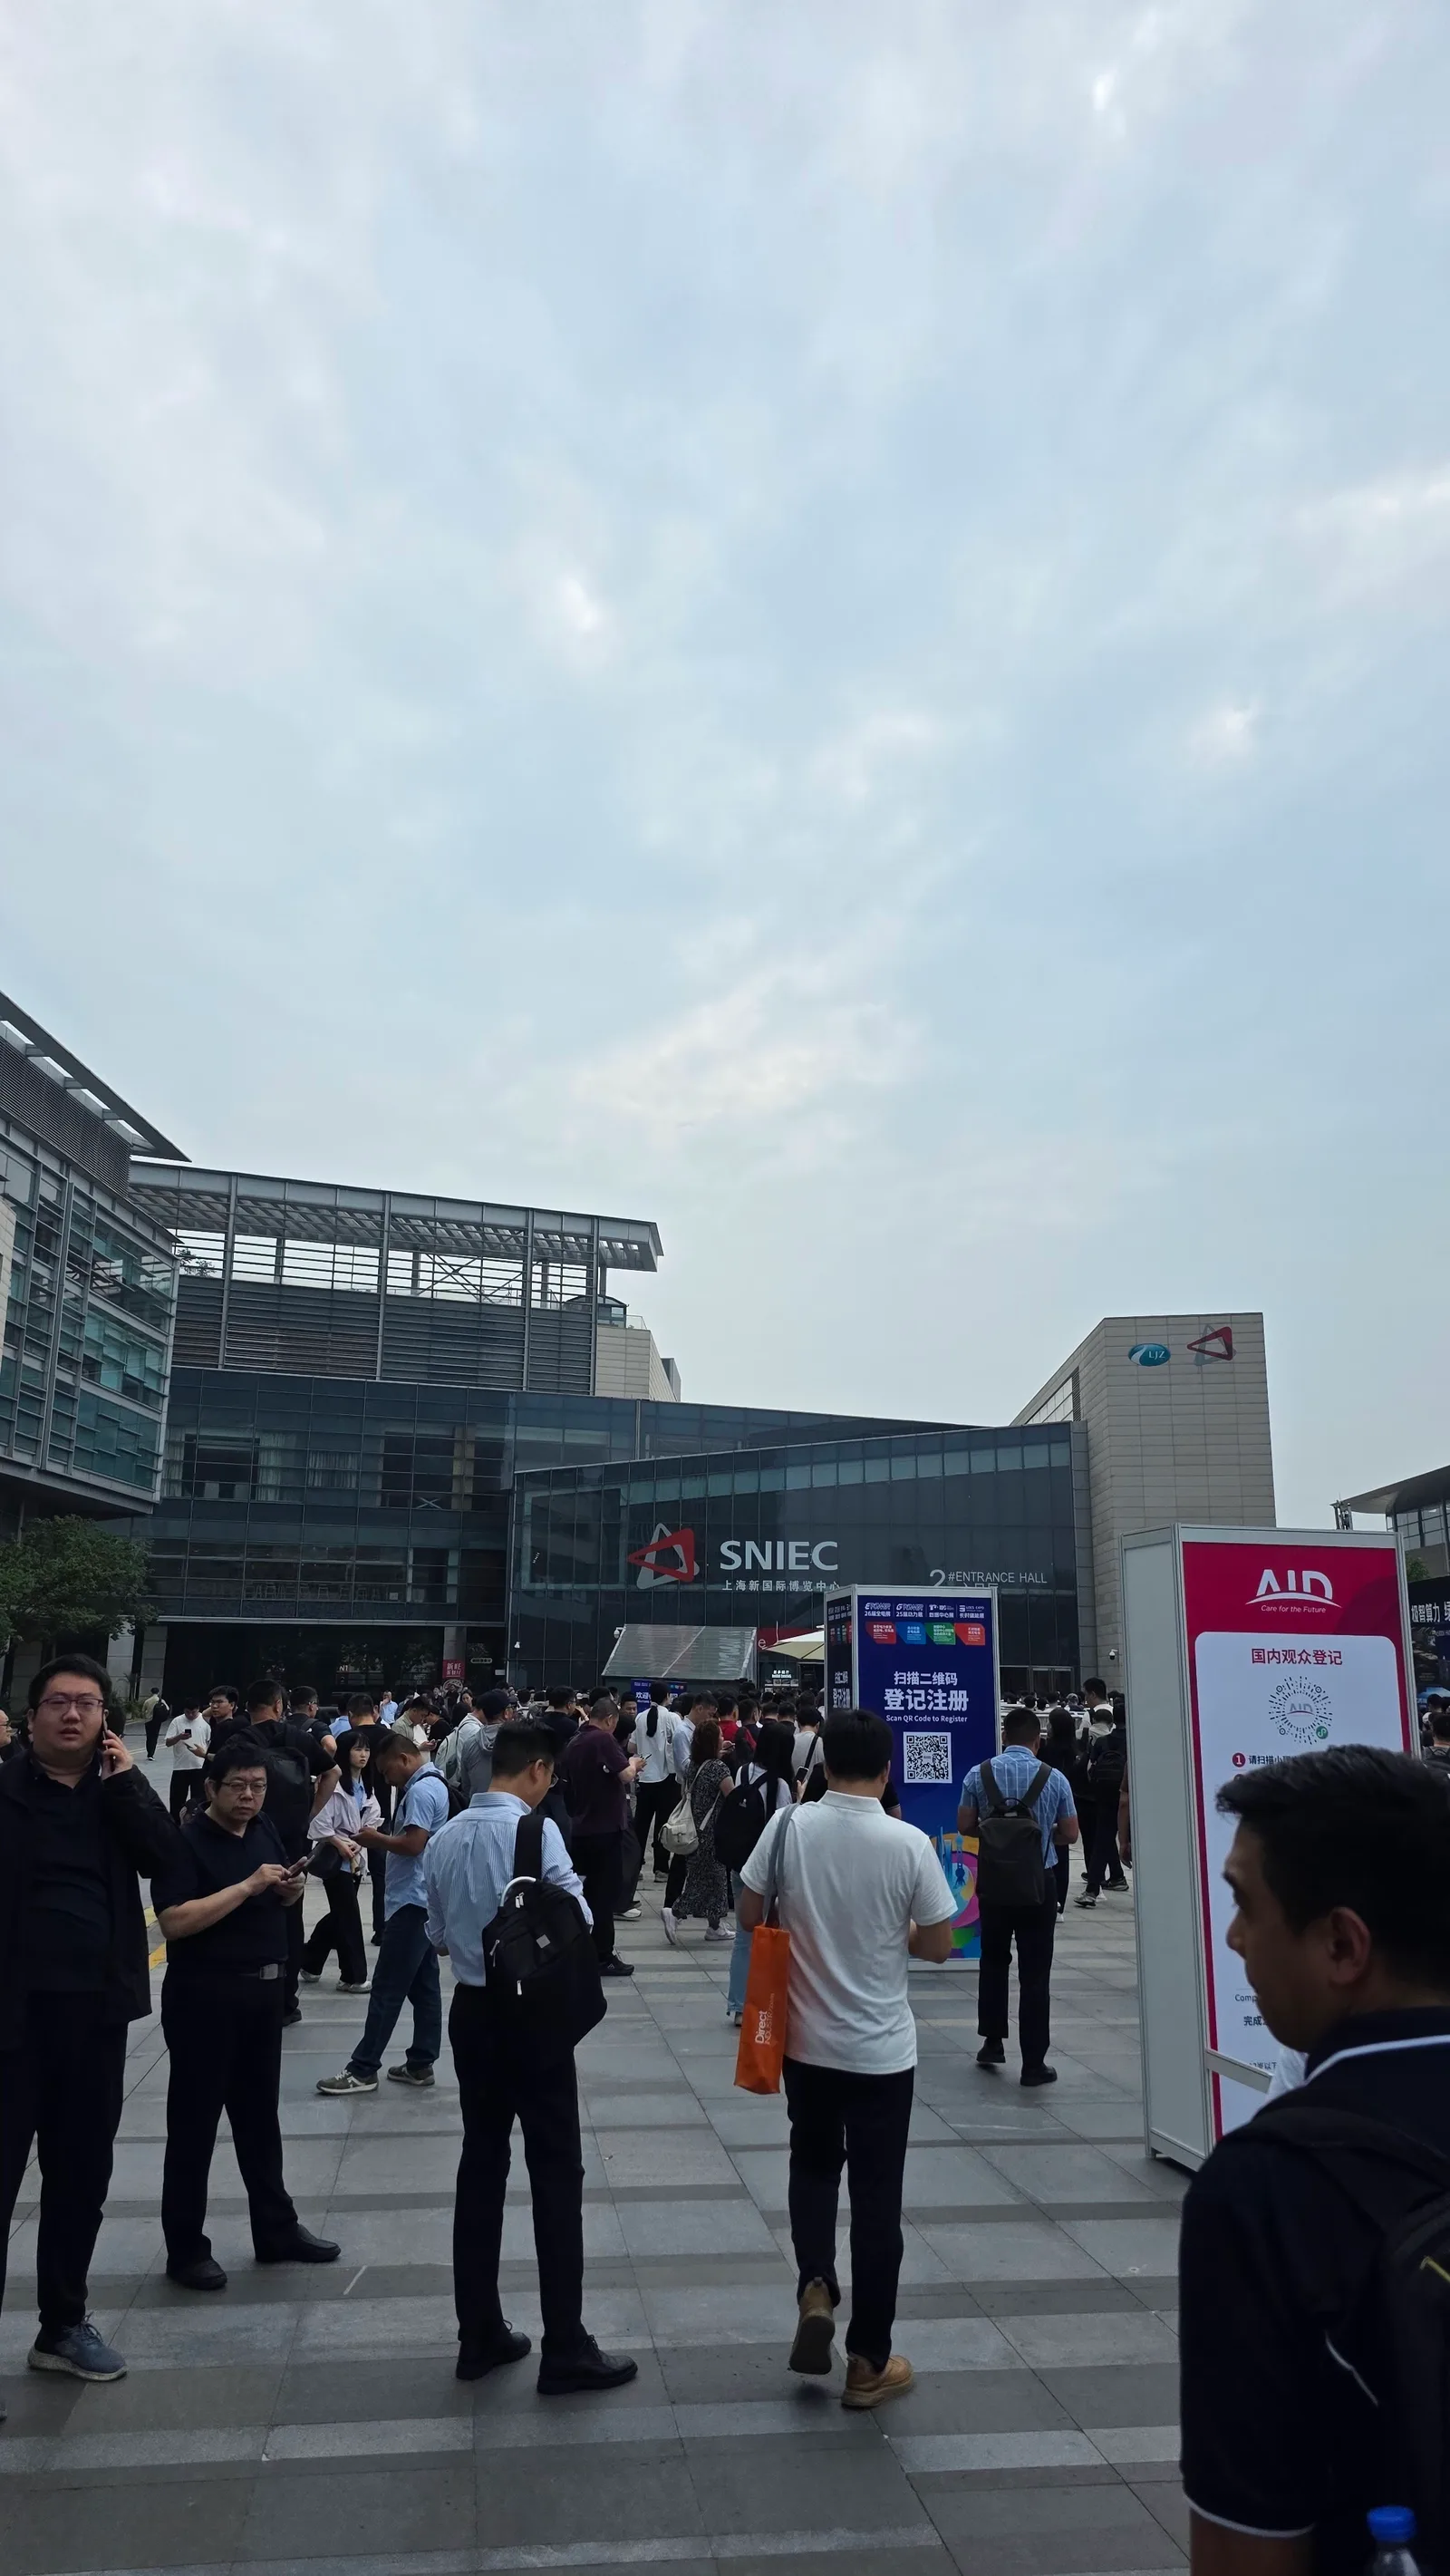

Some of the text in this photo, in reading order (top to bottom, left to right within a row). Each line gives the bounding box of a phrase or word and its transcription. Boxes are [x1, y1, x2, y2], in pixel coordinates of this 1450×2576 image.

[1148, 1351, 1165, 1360] LJZ
[720, 1540, 838, 1571] SNIEC
[1019, 1572, 1048, 1583] HALL
[1256, 1569, 1333, 1600] AID
[722, 1580, 840, 1592] 上海新国际博览中心
[1261, 1604, 1327, 1613] Care for the Future
[1252, 1648, 1343, 1665] 国内观众登记
[894, 1671, 958, 1686] 扫描二维码
[884, 1689, 969, 1711] 登记注册
[904, 1715, 914, 1723] QR
[941, 1716, 968, 1724] Register
[755, 2010, 768, 2044] Direct
